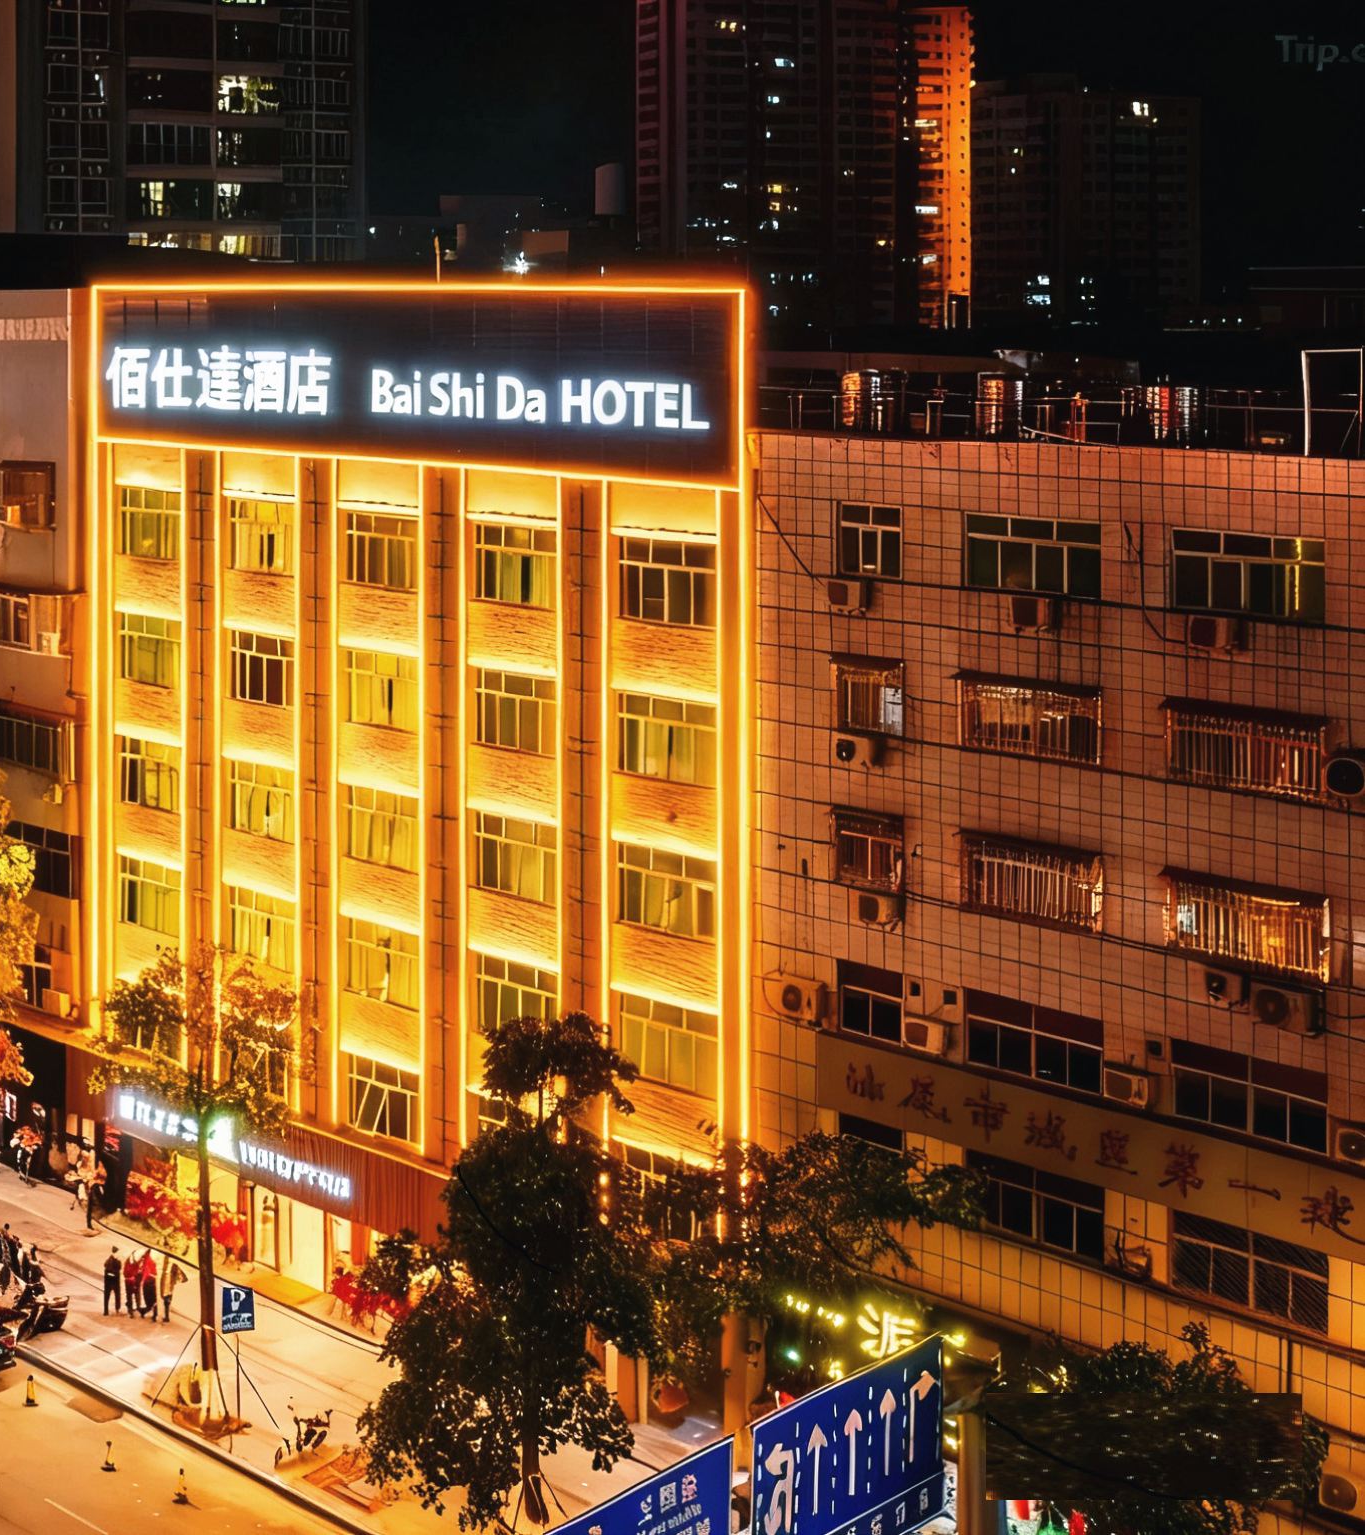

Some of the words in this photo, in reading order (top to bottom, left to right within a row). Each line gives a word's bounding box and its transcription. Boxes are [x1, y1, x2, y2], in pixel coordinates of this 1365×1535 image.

[105, 344, 333, 417] 佰仕達酒店
[561, 378, 710, 430] HOTEL
[230, 1289, 246, 1311] P
